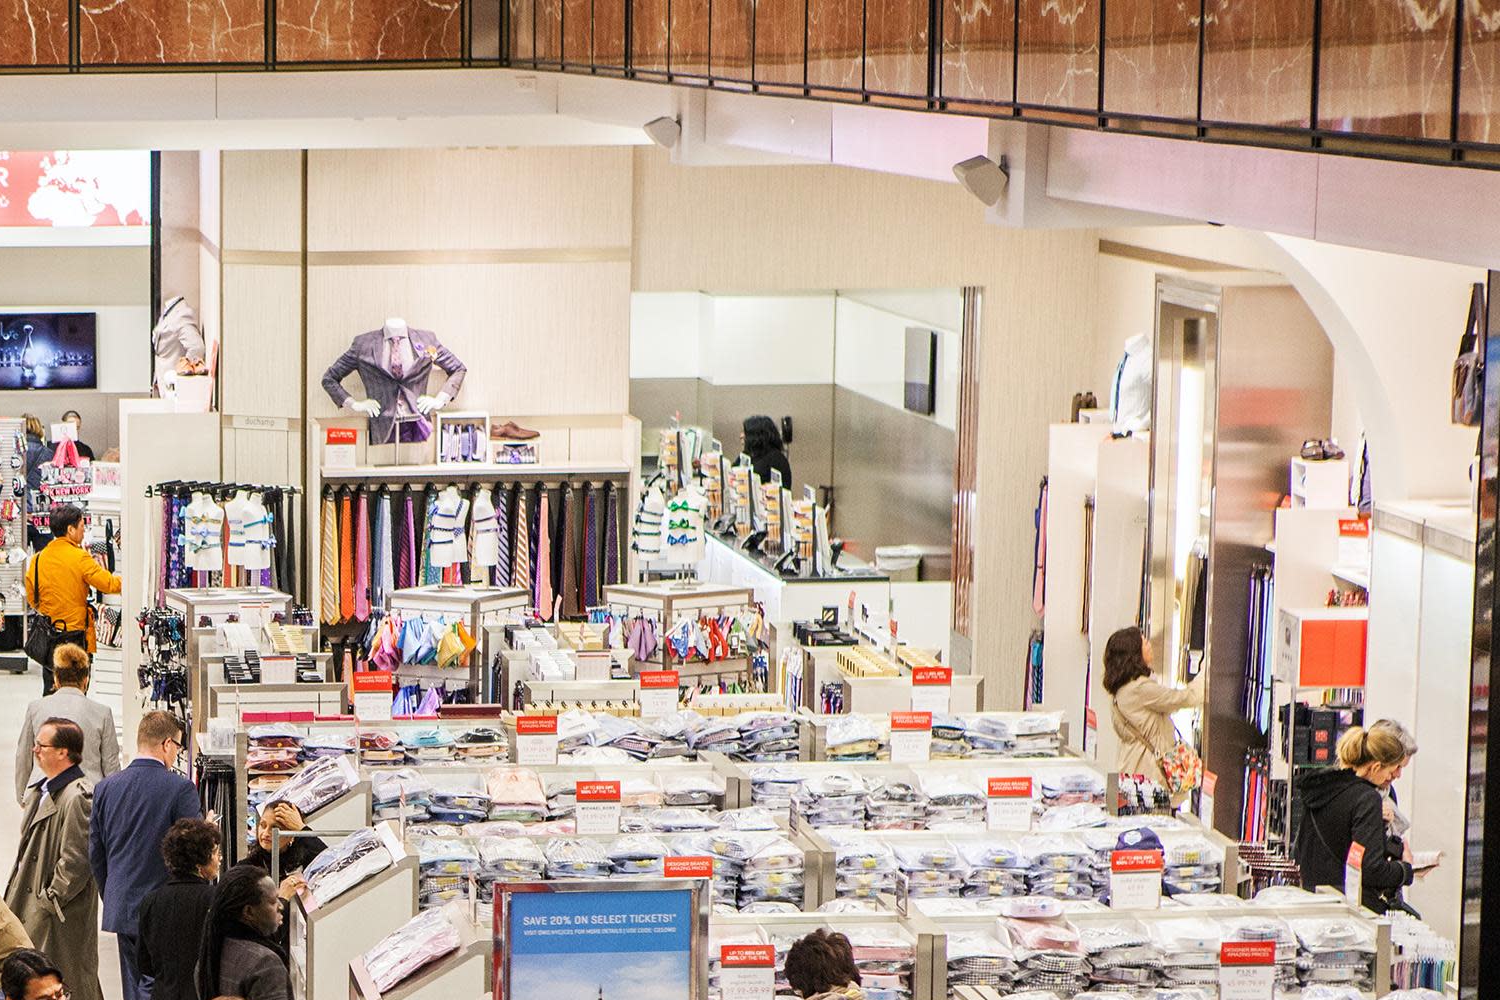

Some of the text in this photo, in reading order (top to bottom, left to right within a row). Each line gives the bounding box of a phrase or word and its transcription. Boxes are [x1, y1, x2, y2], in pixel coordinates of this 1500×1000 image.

[523, 916, 548, 926] SAVE
[550, 916, 571, 926] 20%
[574, 915, 588, 924] ON
[591, 915, 626, 924] SELECT
